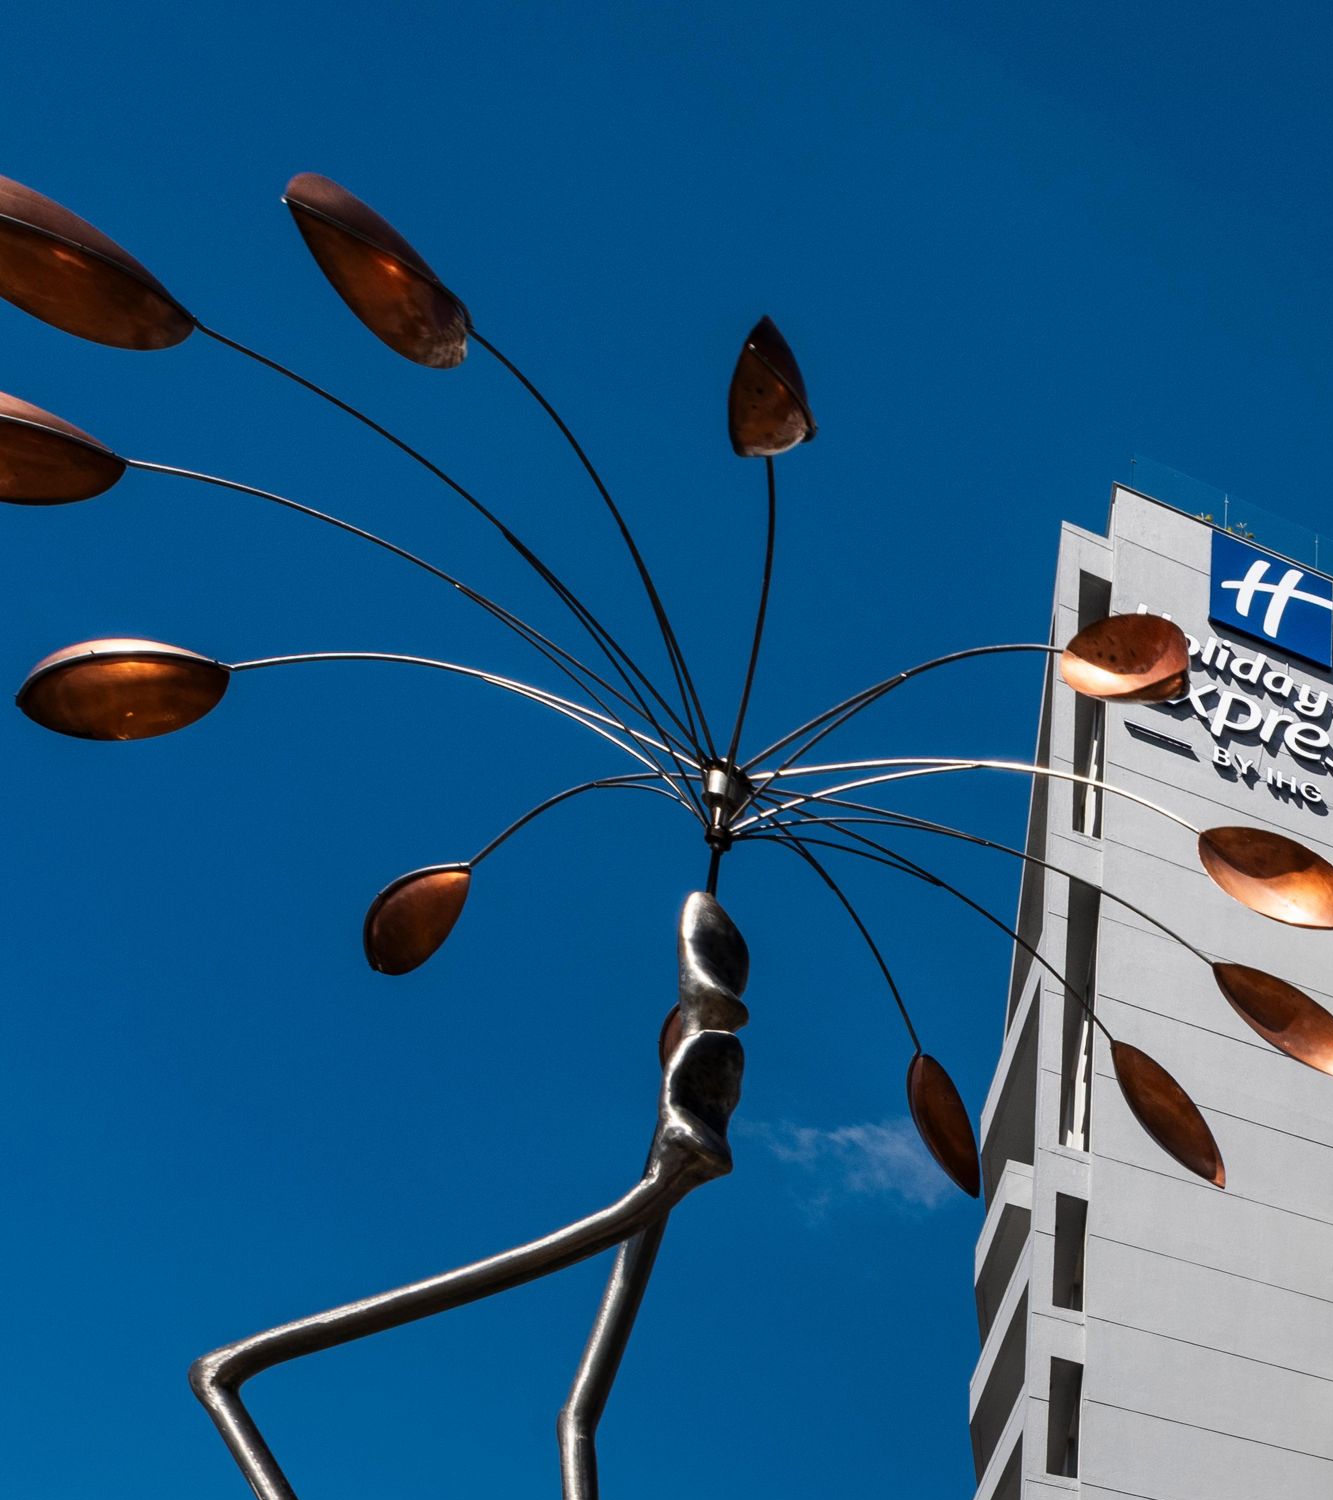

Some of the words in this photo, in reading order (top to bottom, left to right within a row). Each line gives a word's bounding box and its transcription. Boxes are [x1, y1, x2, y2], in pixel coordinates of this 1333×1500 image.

[1137, 603, 1329, 717] oliday
[1213, 746, 1254, 775] BY
[1267, 767, 1322, 802] IHG
